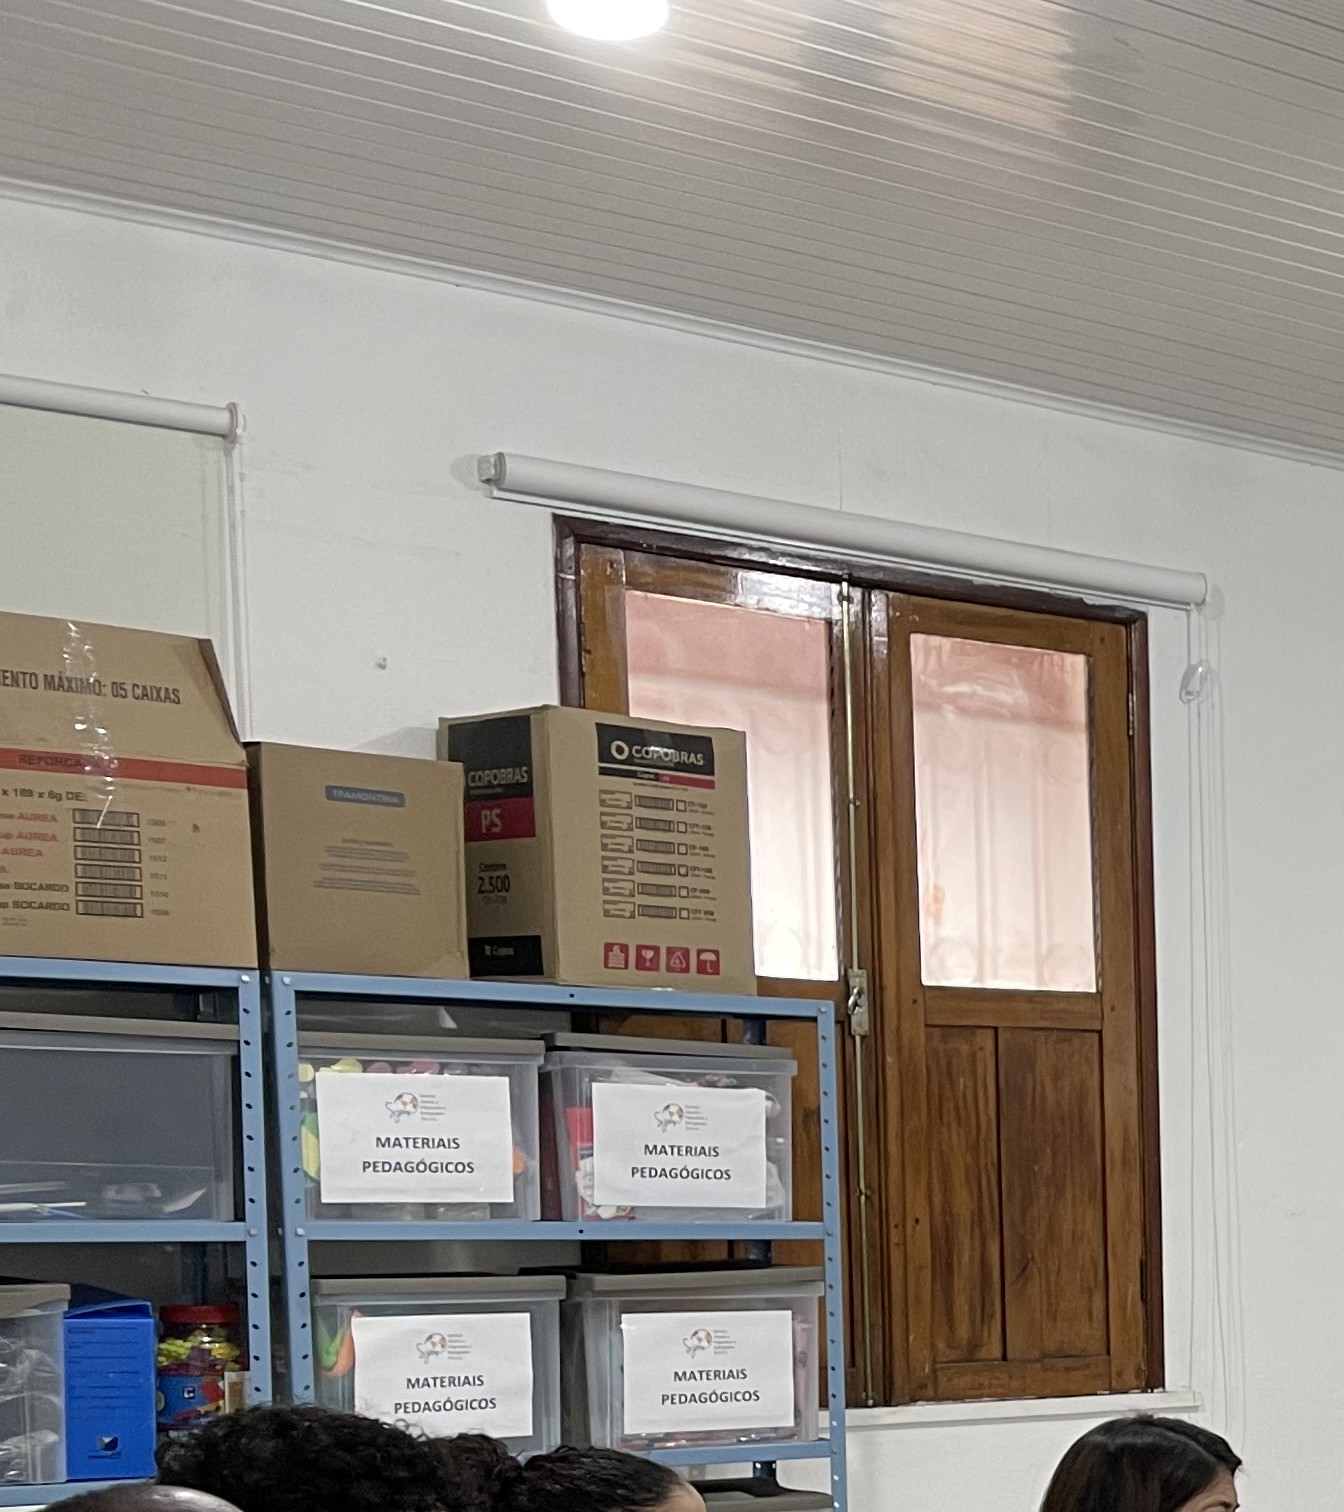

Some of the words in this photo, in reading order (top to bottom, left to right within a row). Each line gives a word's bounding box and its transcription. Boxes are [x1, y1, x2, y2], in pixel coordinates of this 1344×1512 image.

[111, 680, 127, 699] 05
[132, 683, 181, 704] CAIXAS
[632, 745, 704, 766] COPOBRAS
[468, 766, 528, 787] COPOBRAS
[481, 809, 501, 833] PS
[375, 1136, 461, 1150] MATERIAIS
[643, 1144, 720, 1158] MATERIAIS
[362, 1158, 475, 1174] PEDAGÓGICOS
[631, 1165, 732, 1181] PEDAGÓGICOS
[406, 1374, 485, 1390] MATERIAIS
[673, 1368, 748, 1382] MATERIAIS
[394, 1397, 497, 1415] PEDAGÓGICOS
[661, 1390, 760, 1406] PEDAGÓGICOS
